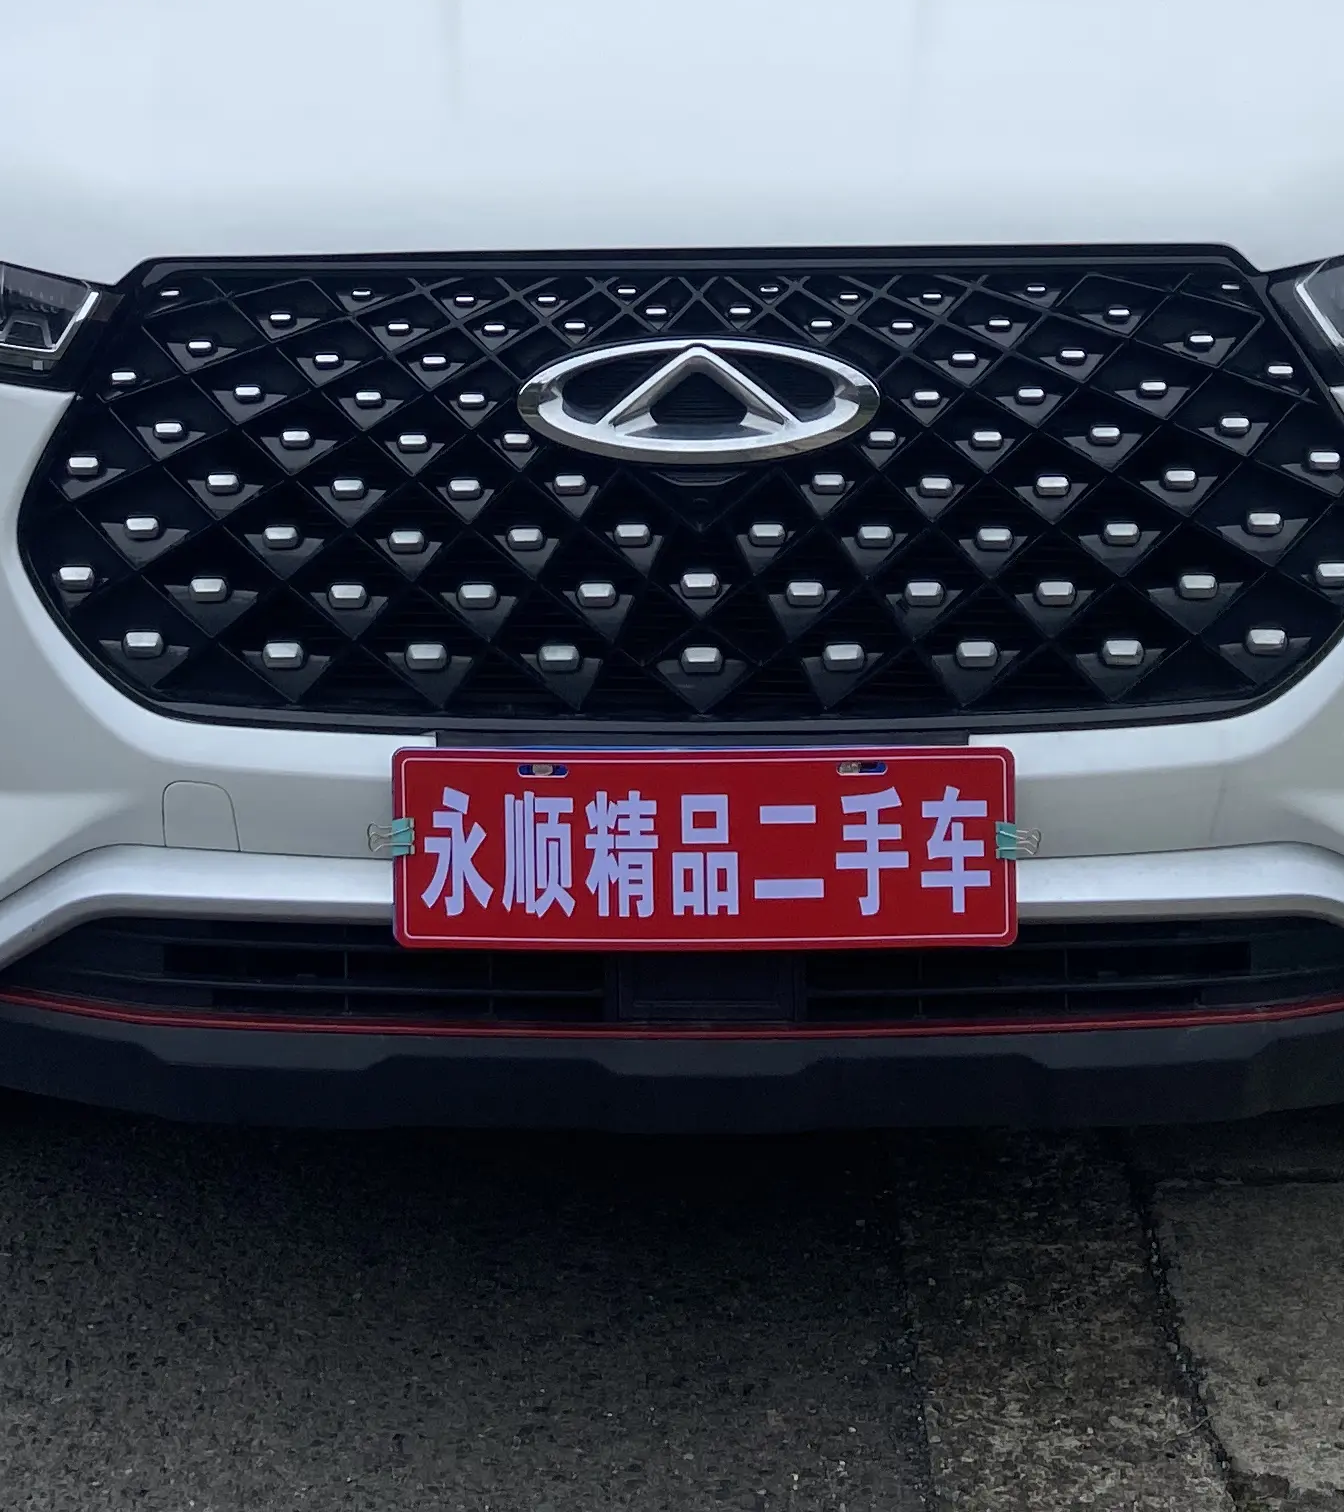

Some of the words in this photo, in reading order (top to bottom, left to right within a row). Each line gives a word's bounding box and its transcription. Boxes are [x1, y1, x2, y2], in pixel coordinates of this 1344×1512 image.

[421, 786, 991, 917] 永顺精品二手车
